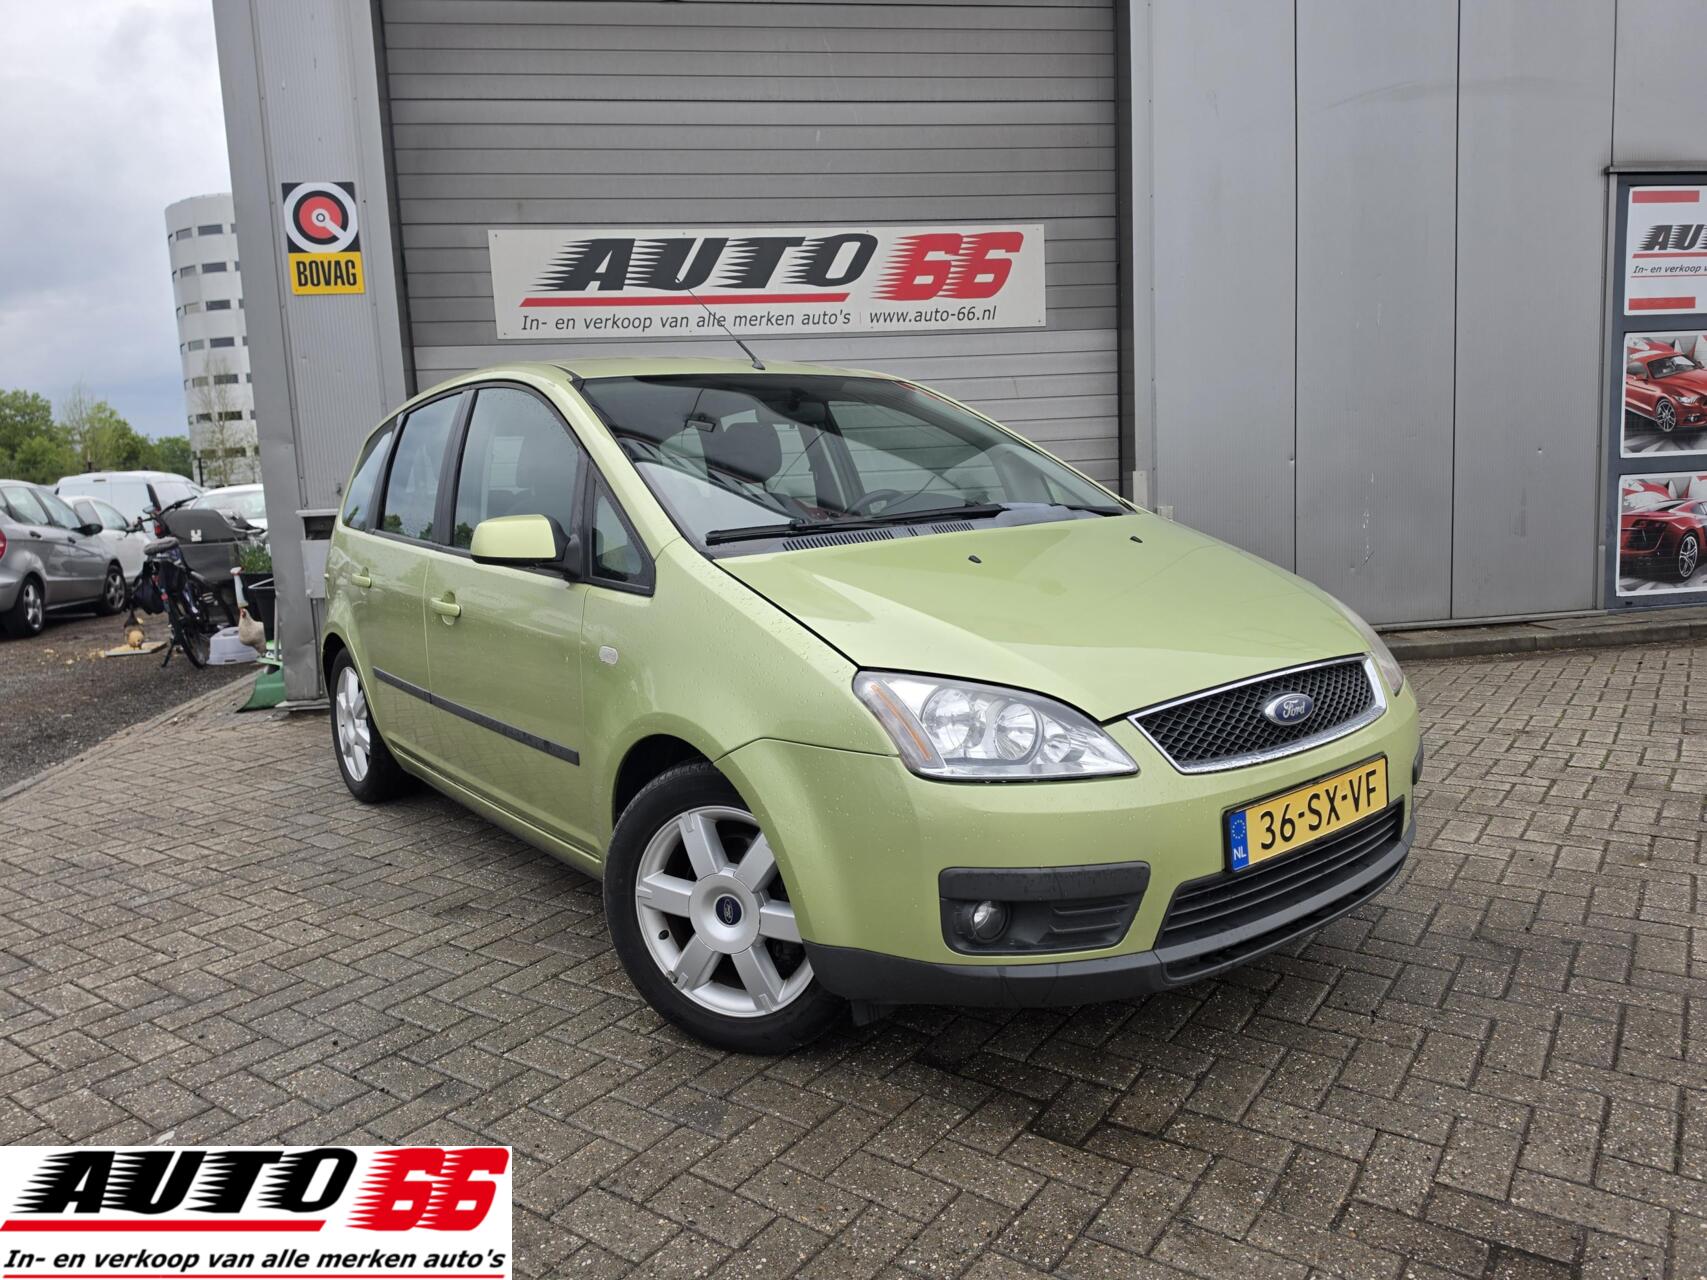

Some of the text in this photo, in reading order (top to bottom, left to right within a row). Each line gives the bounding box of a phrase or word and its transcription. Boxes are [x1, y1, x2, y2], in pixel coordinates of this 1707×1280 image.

[1636, 224, 1707, 251] AU
[296, 259, 357, 287] BOVAG
[525, 231, 1024, 301] AUTO 66
[1633, 265, 1648, 274] In-
[1665, 264, 1702, 274] verkoop
[521, 309, 851, 332] In- en verkoop van alle merken auto's
[869, 305, 997, 324] www.auto-66.nl
[1283, 699, 1305, 718] Ford
[1260, 769, 1377, 850] 36-SX-VF
[1233, 846, 1247, 860] NL
